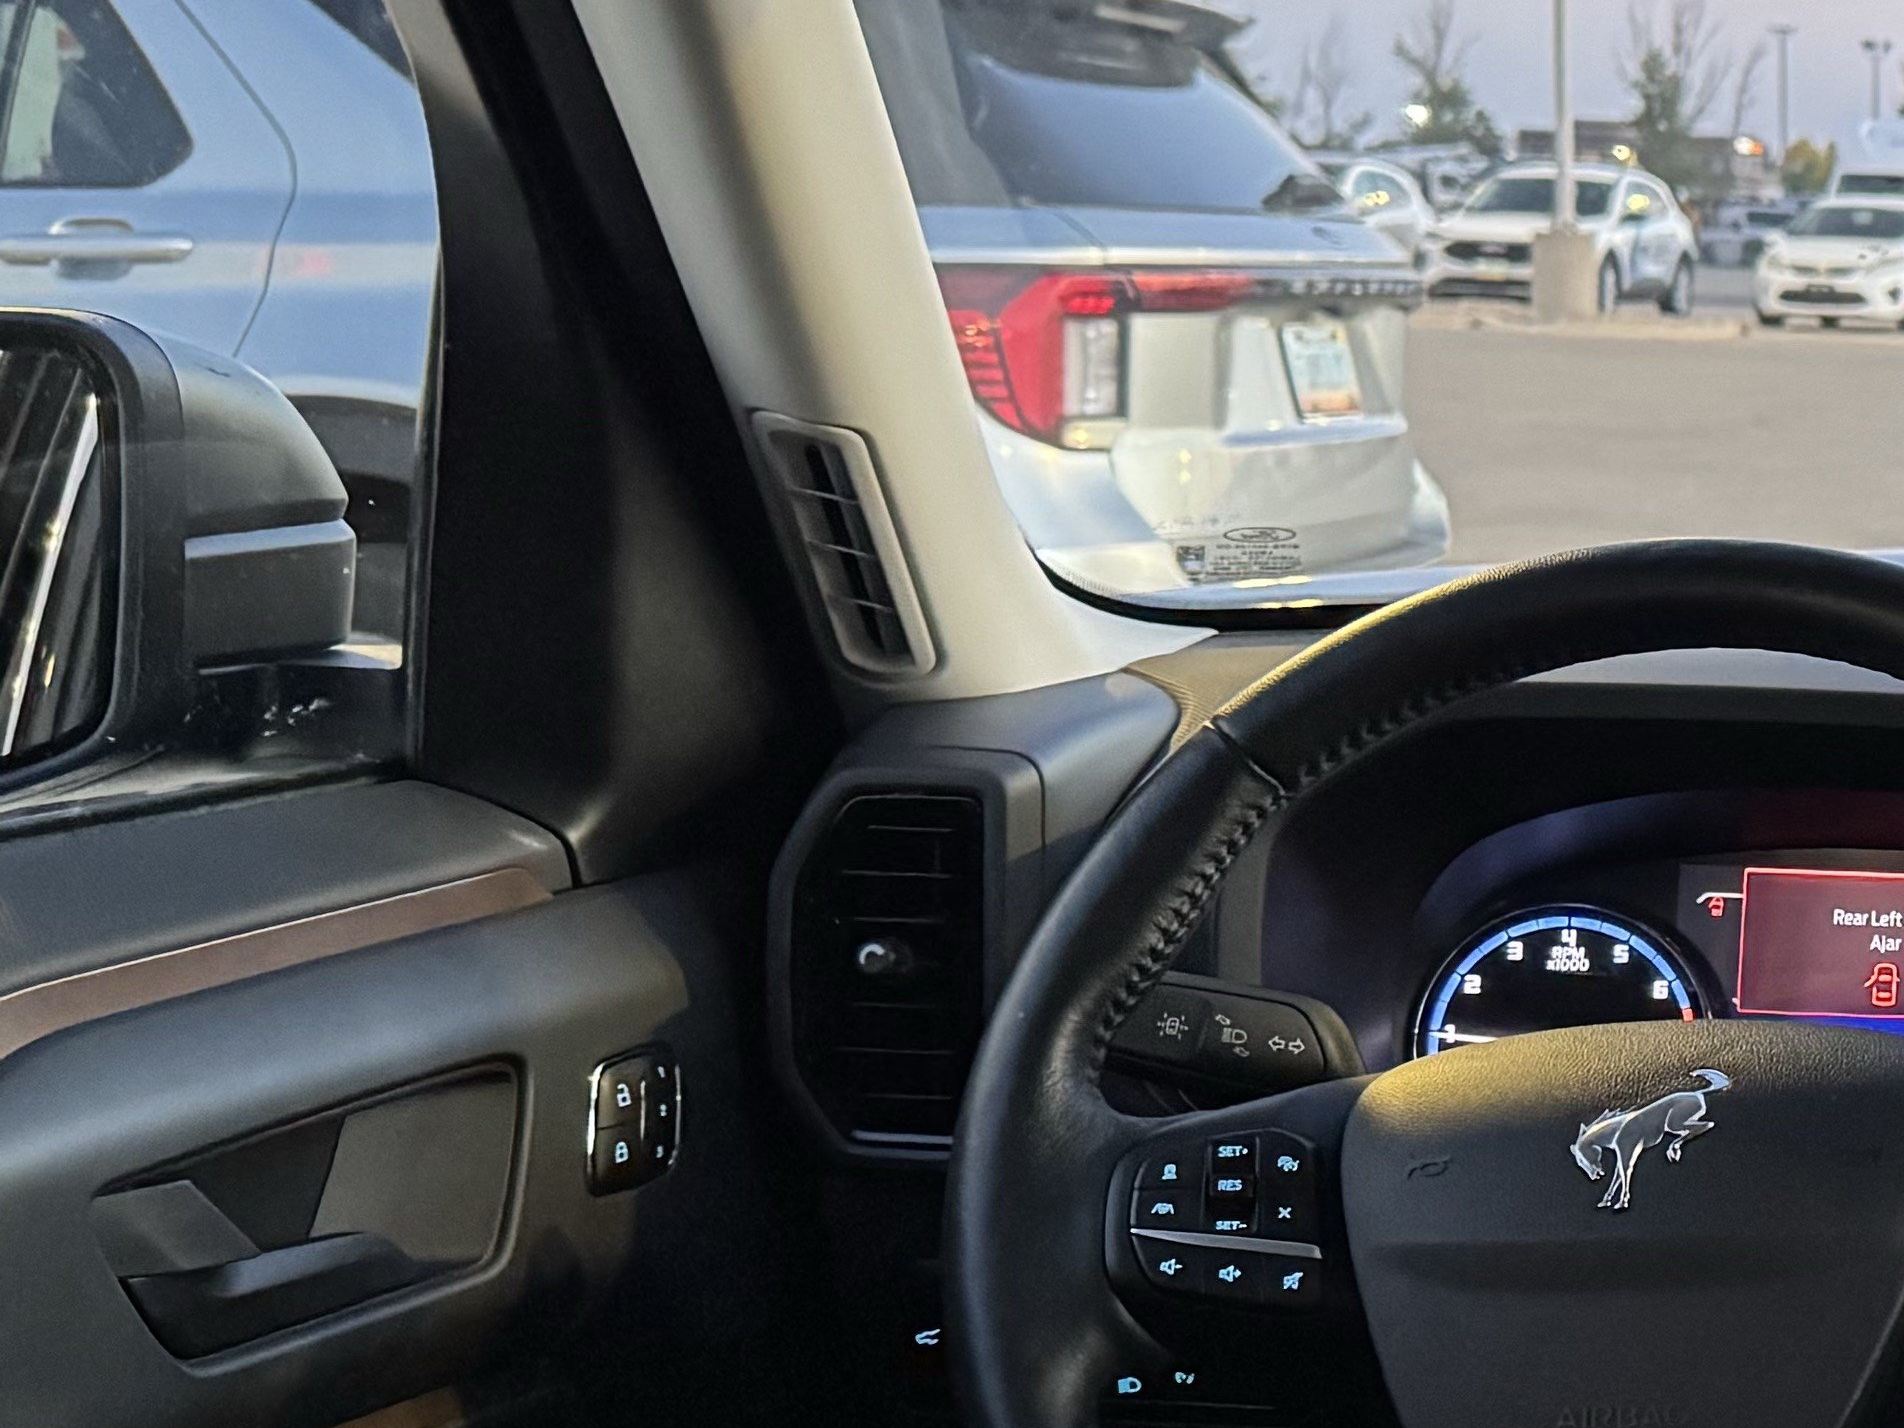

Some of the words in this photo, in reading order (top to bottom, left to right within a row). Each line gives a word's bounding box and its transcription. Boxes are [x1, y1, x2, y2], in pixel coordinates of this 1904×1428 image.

[1833, 909, 1869, 928] Rear
[1871, 910, 1902, 929] Left
[1561, 929, 1577, 945] 4
[1870, 934, 1902, 954] Ajar
[1507, 942, 1524, 961] 3
[1551, 946, 1585, 959] RPM
[1614, 944, 1630, 964] 5
[1546, 958, 1590, 972] x1000
[1463, 974, 1482, 994] 2
[1652, 980, 1670, 1000] 6
[1218, 1179, 1242, 1192] RES
